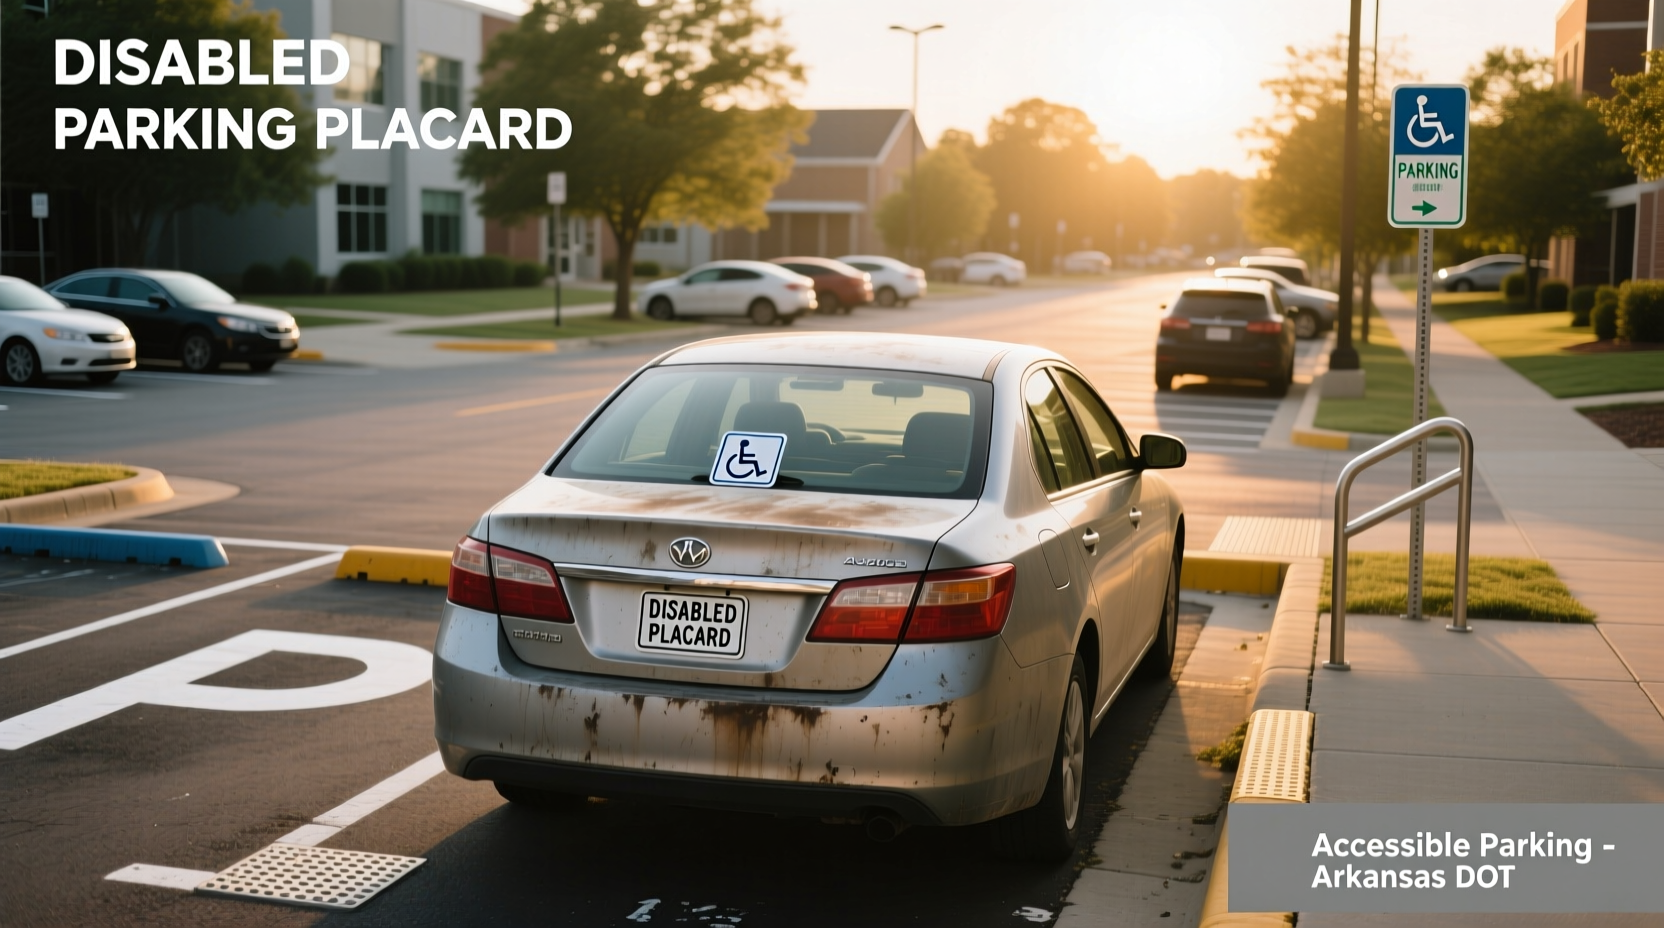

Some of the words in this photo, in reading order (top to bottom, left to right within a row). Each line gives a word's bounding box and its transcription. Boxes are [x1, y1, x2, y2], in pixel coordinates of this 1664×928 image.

[1397, 162, 1459, 180] PARKING
[649, 598, 737, 624] DISABLED
[648, 624, 731, 648] PLACARD
[0, 629, 434, 751] P
